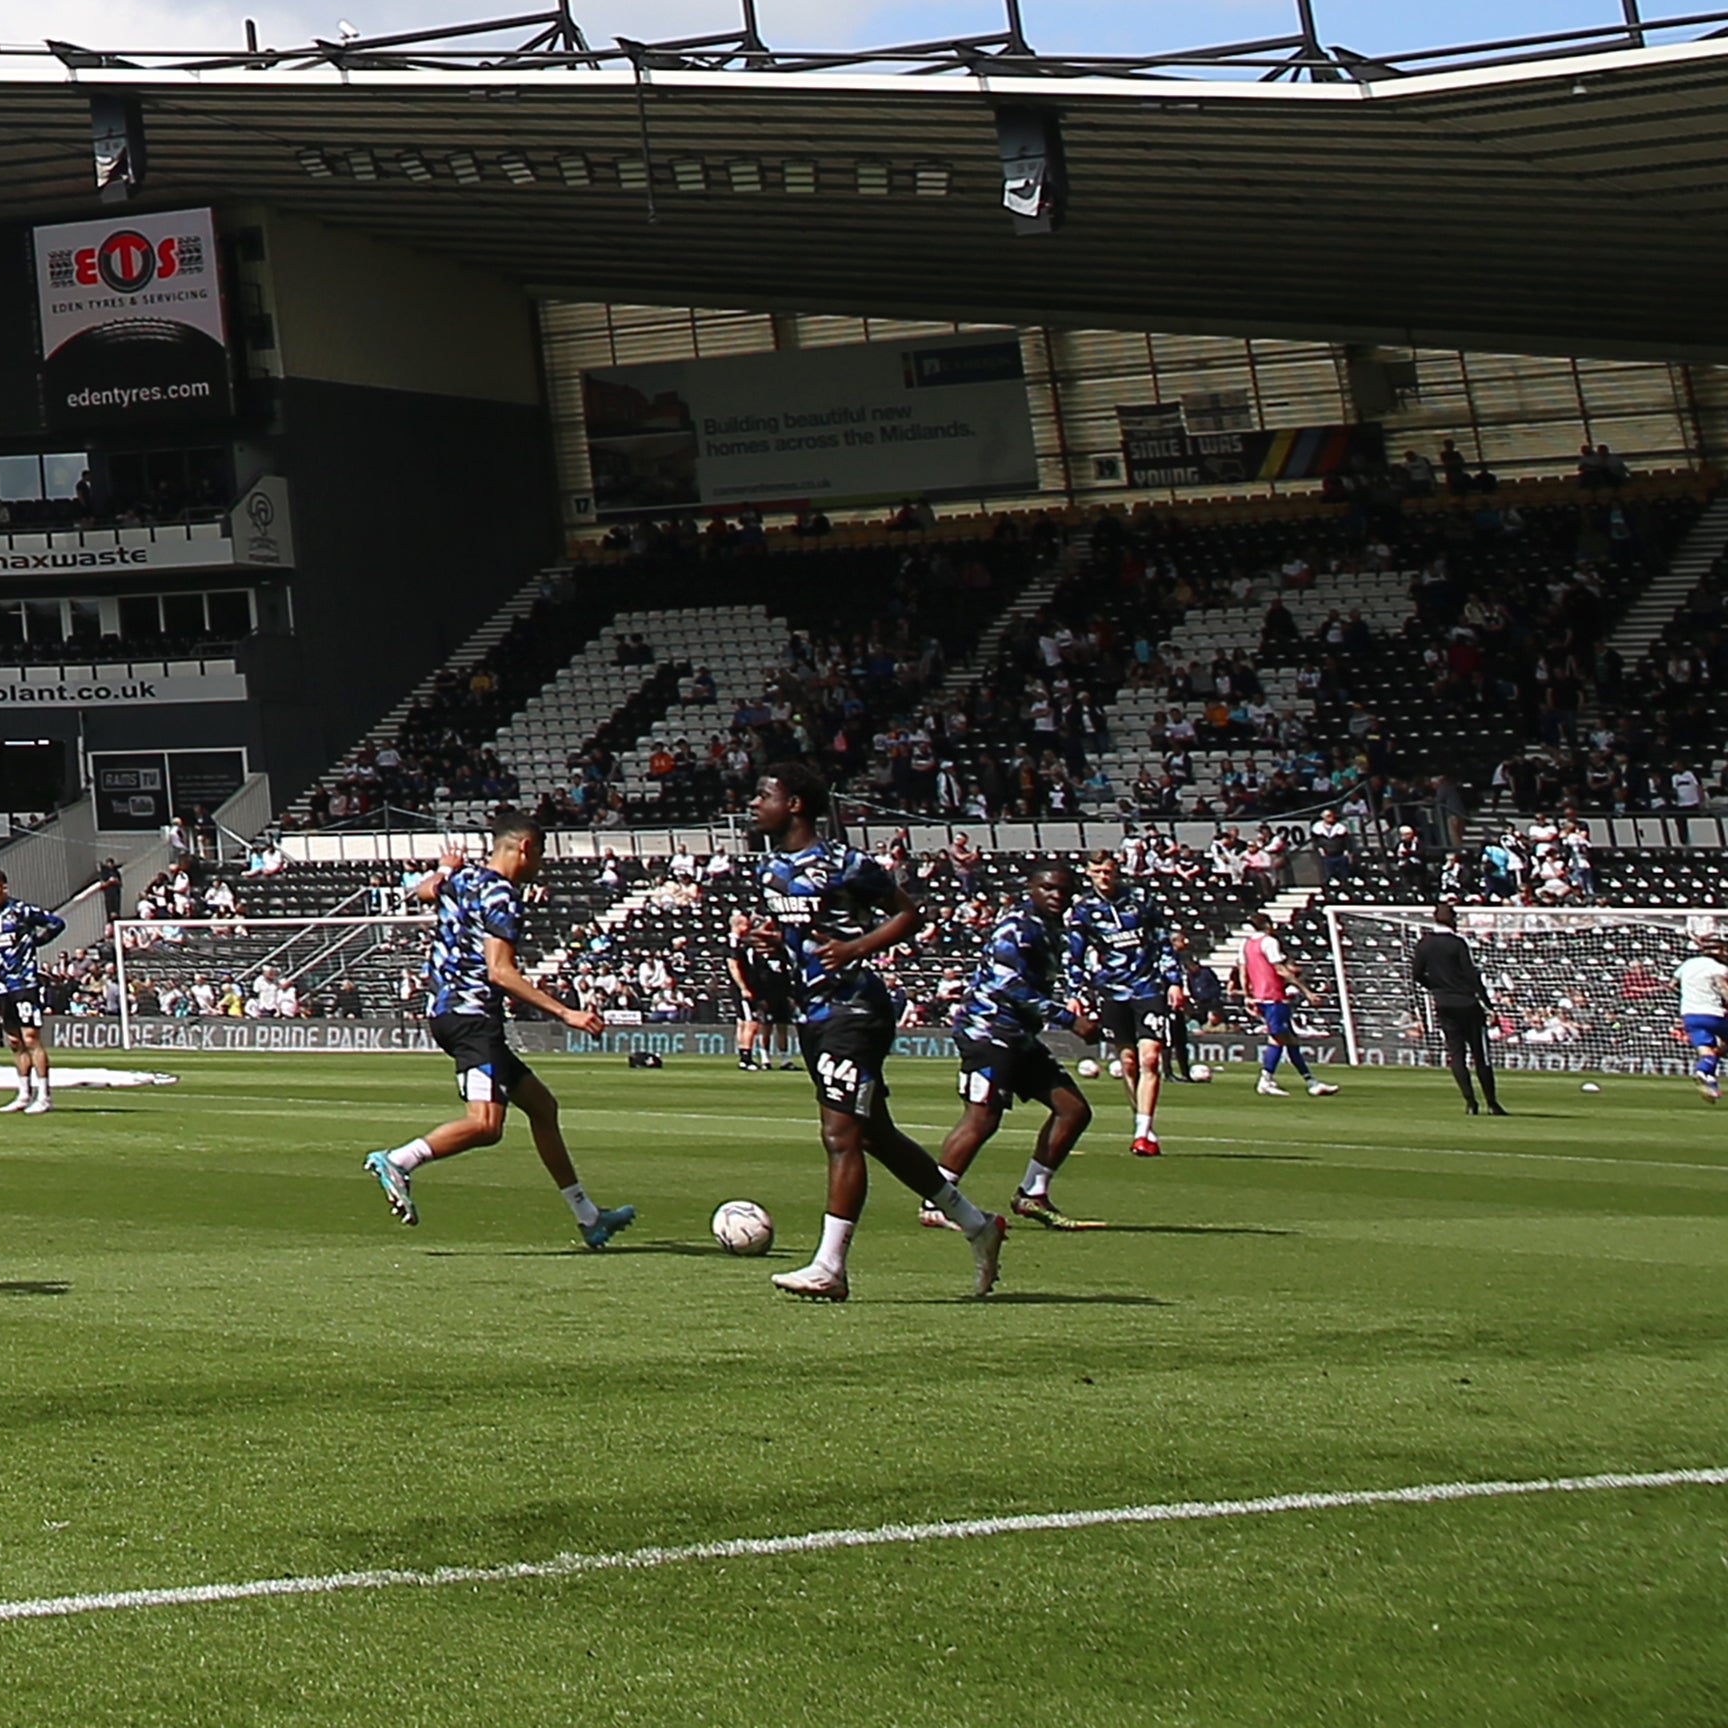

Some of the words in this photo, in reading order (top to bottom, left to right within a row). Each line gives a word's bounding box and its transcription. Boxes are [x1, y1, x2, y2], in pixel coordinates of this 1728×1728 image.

[74, 234, 176, 286] ETS
[52, 302, 84, 314] EDEN
[89, 296, 125, 309] TYRES
[130, 296, 137, 306] &
[142, 289, 208, 306] SERVICING
[66, 382, 210, 408] edentyres.com
[704, 414, 779, 436] Building
[784, 405, 866, 429] beautiful
[872, 404, 912, 421] new
[706, 436, 770, 457] homes
[775, 434, 839, 452] across
[844, 427, 874, 447] the
[880, 420, 976, 444] Midlands.
[1129, 438, 1182, 460] SINCE
[1186, 437, 1193, 456] I
[1198, 435, 1244, 456] WAS
[1132, 466, 1200, 488] YOUNG
[105, 773, 137, 786] RAMS
[224, 1025, 247, 1049] TO
[255, 1026, 319, 1050] PRIDE
[326, 1027, 382, 1050] PARK
[694, 1032, 726, 1055] TO
[817, 1052, 858, 1092] 44
